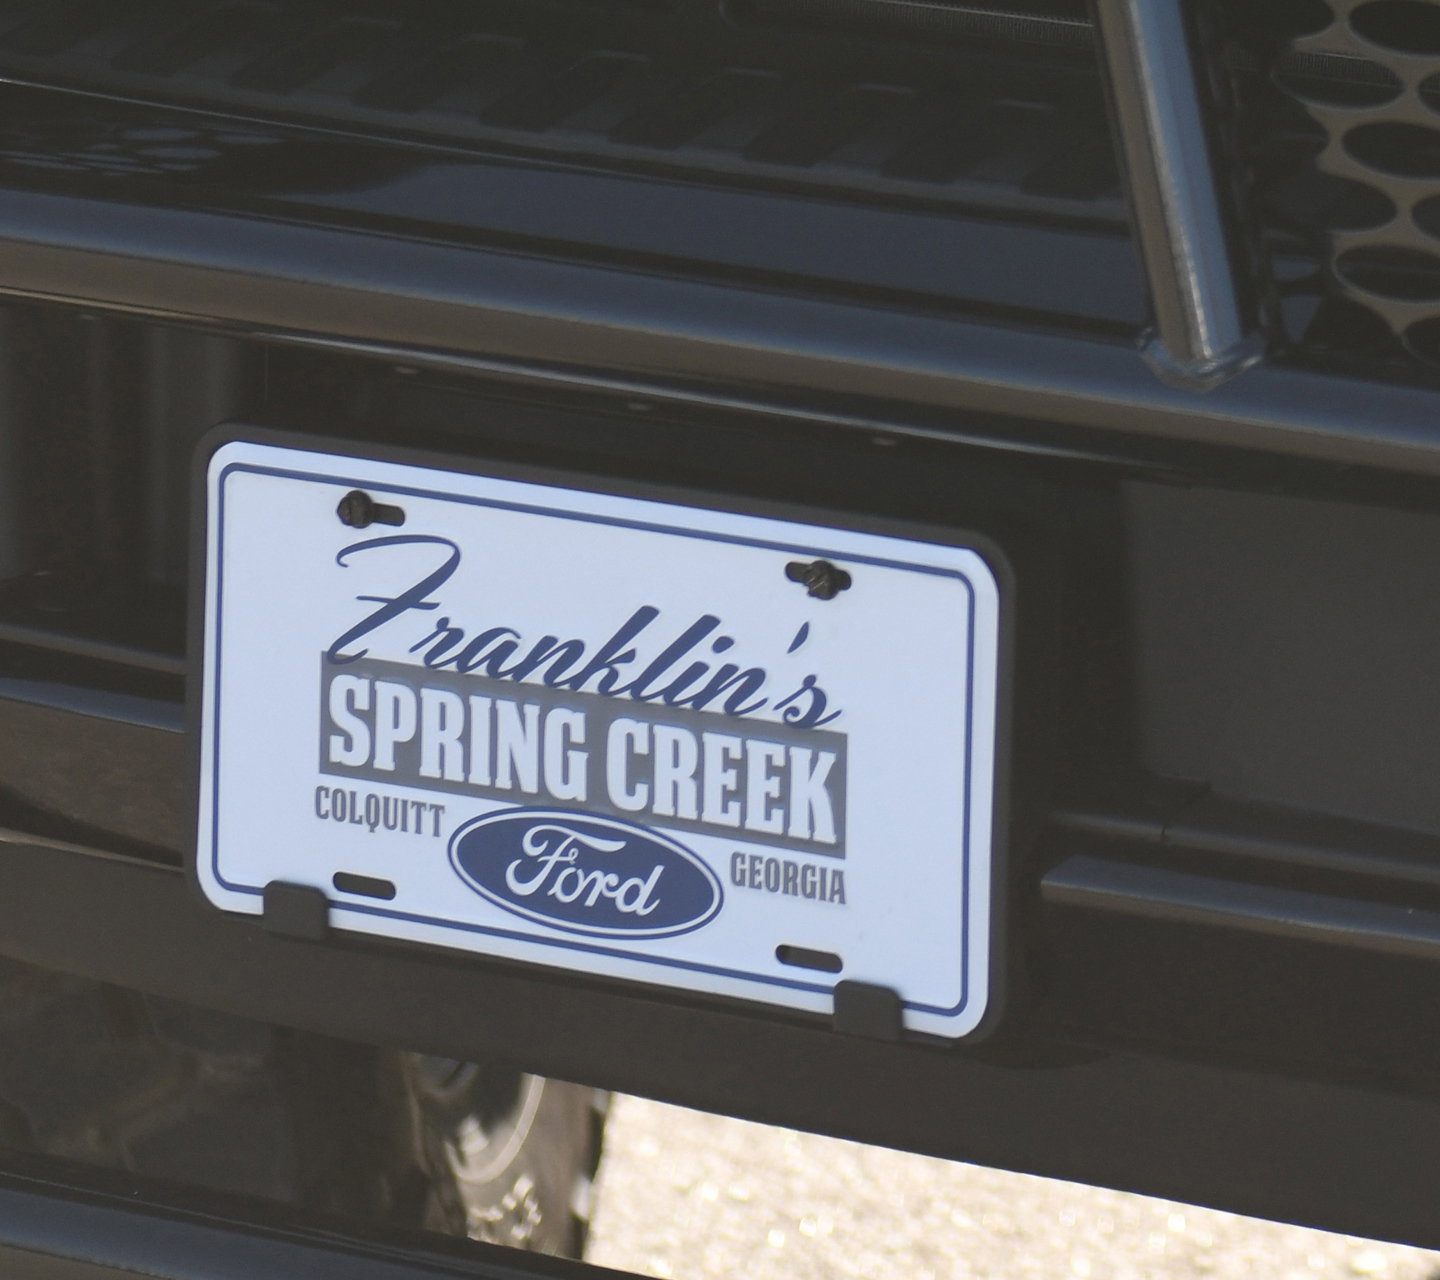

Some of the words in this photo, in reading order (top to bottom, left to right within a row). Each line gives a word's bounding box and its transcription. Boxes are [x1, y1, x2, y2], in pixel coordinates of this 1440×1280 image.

[326, 534, 843, 729] Franklin's
[328, 674, 588, 802] SPRING
[606, 717, 837, 845] CREEK
[314, 785, 446, 838] COLQUITT
[504, 824, 664, 917] Ford
[730, 852, 846, 905] GEORGIA
